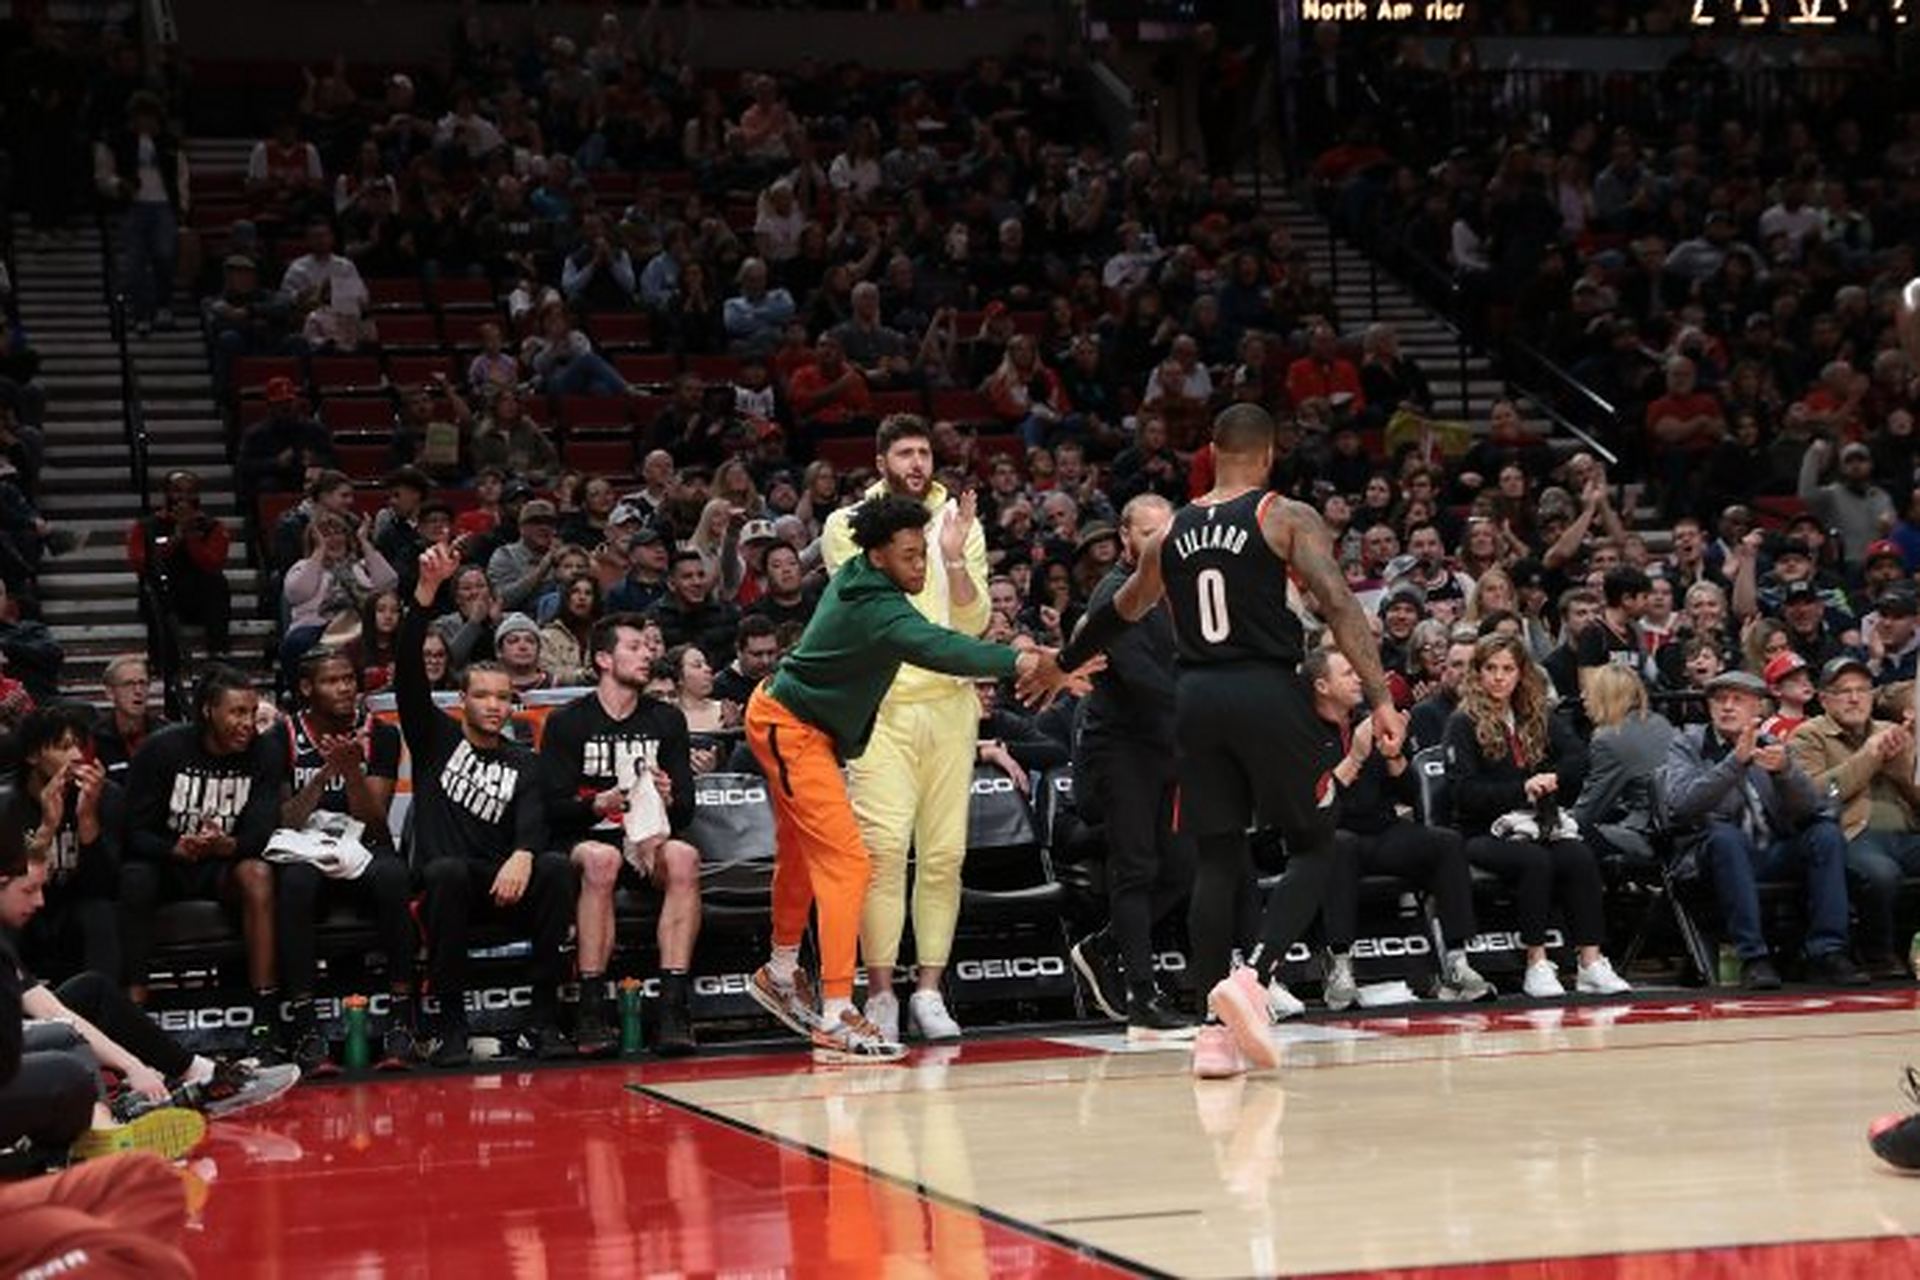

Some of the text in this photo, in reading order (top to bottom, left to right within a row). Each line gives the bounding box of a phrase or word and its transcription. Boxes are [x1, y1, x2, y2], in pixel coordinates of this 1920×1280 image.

[1302, 0, 1367, 21] North
[1175, 525, 1248, 559] LILLARD
[1198, 568, 1230, 643] 0
[447, 739, 518, 801] BLACK
[169, 772, 252, 817] BLACK
[695, 787, 767, 806] EICO
[1348, 935, 1431, 958] EICO
[956, 956, 1064, 980] GEICO
[146, 1006, 254, 1031] EICO
